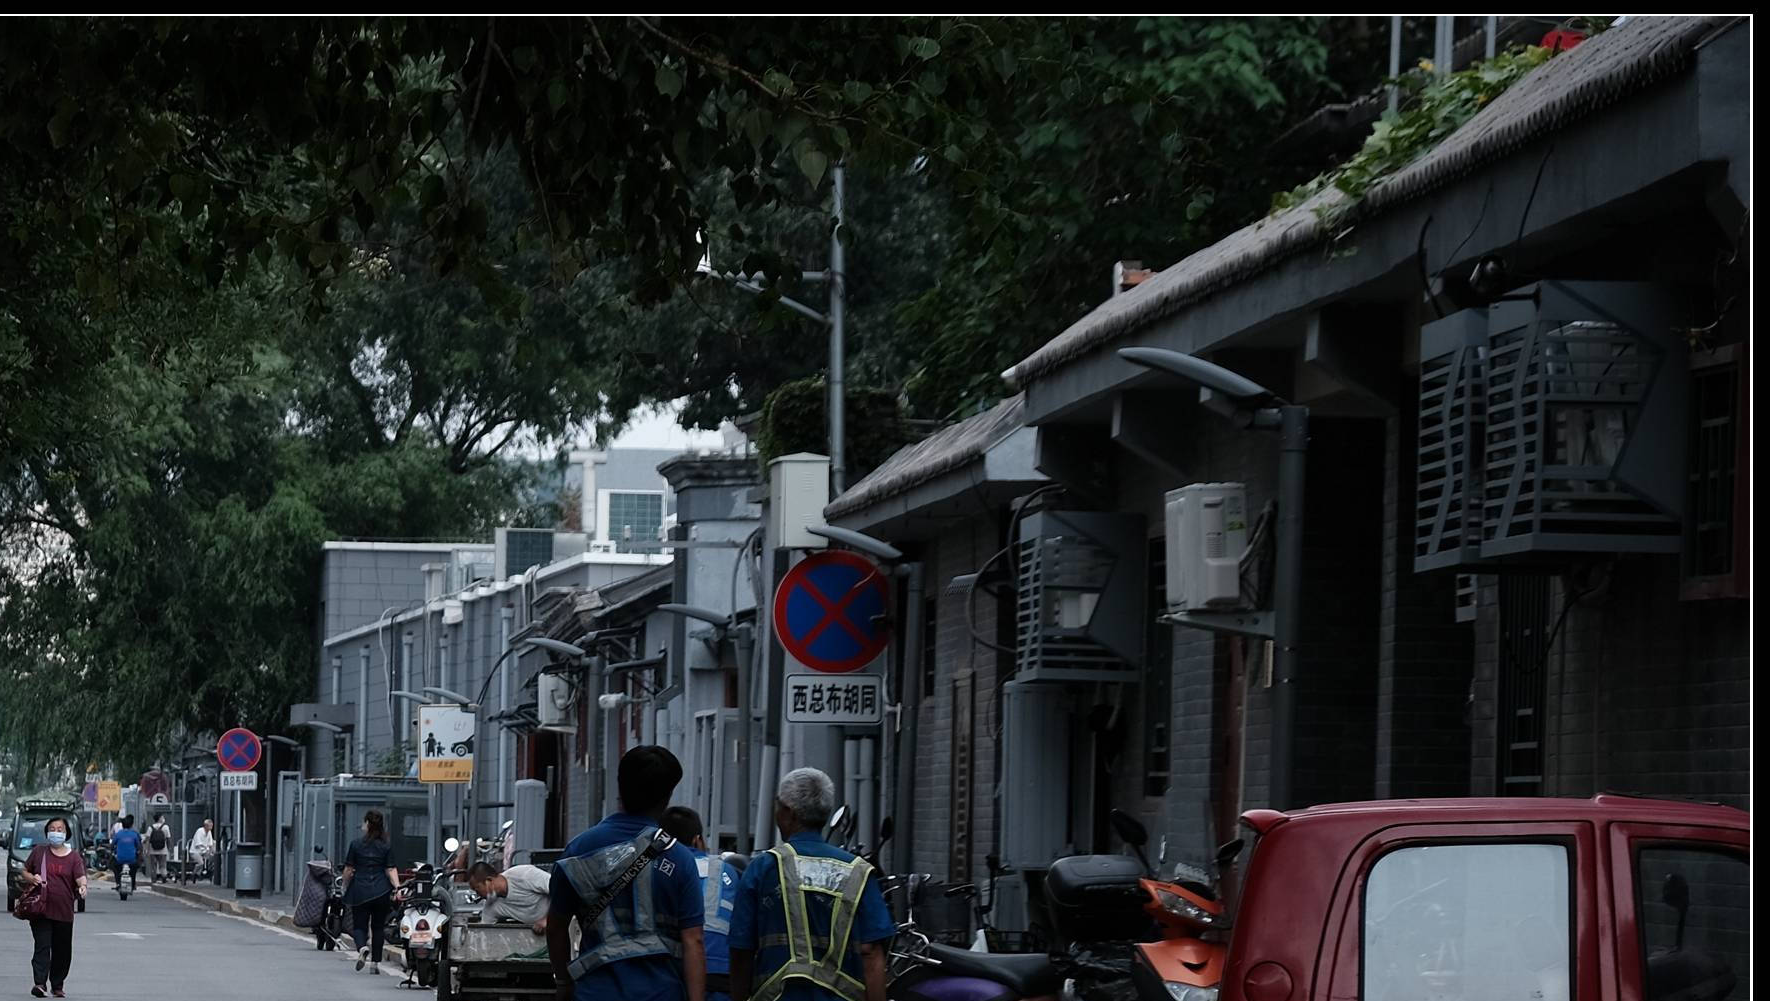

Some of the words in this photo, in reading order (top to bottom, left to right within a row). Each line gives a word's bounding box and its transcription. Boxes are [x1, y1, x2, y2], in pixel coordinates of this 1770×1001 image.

[792, 684, 877, 715] 西总布胡同
